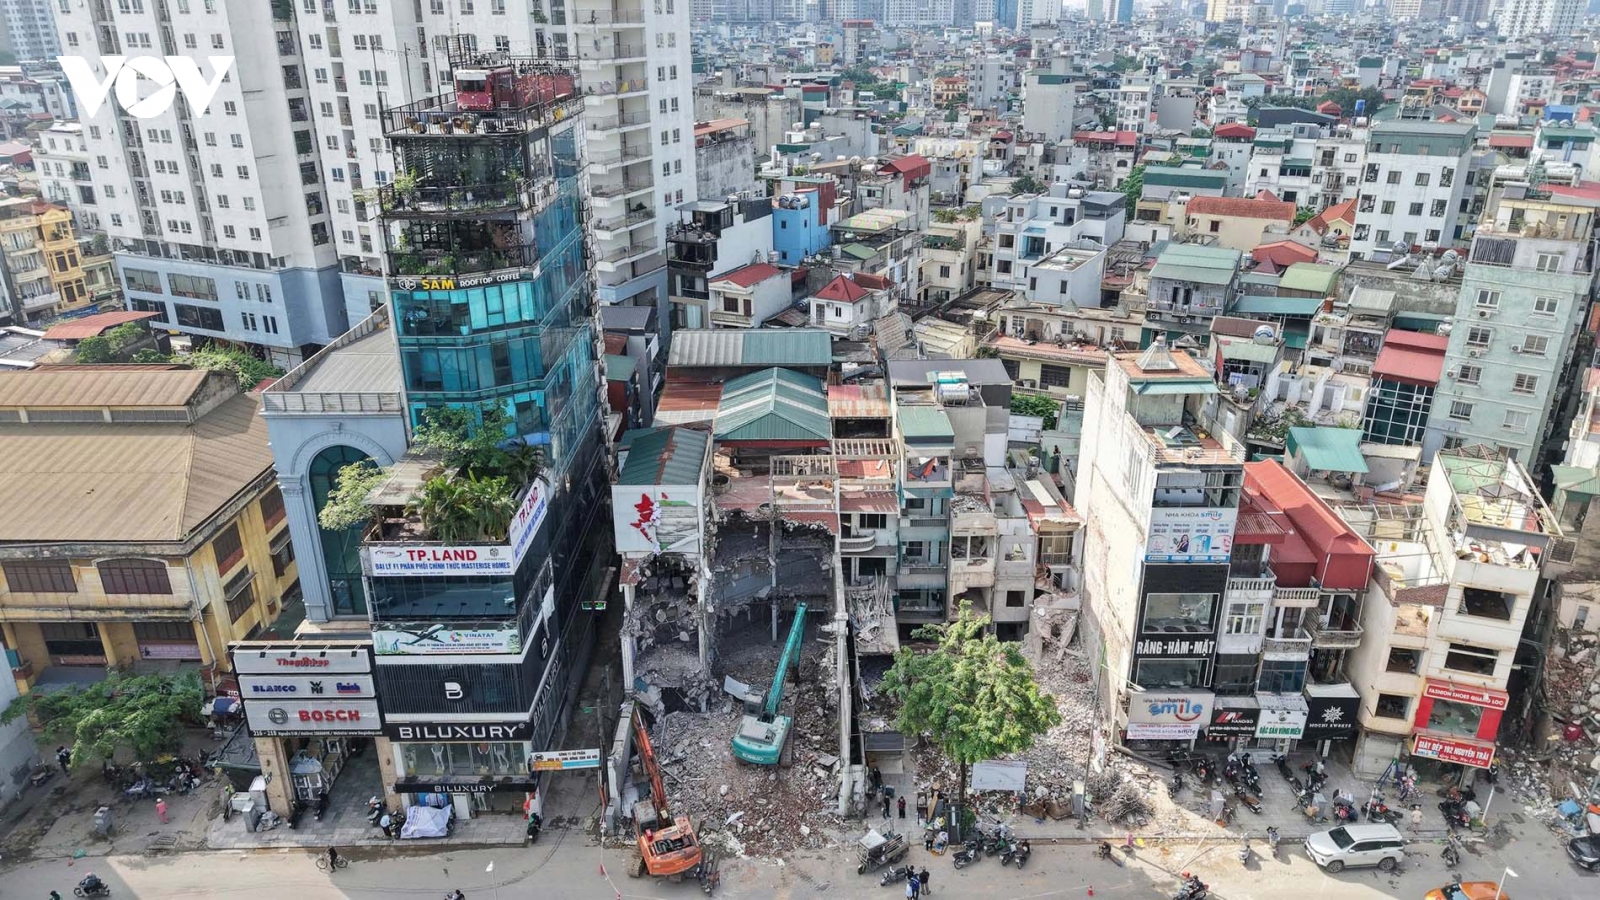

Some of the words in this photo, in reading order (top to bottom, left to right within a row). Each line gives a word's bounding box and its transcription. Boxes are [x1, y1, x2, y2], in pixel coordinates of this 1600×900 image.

[460, 277, 493, 288] ROOFTOP
[496, 273, 520, 282] COFFEE
[406, 549, 478, 562] TP.LAND
[461, 562, 491, 570] MASTERISE
[491, 561, 511, 569] HOMES
[1428, 688, 1452, 696] FASHION
[1452, 692, 1470, 700] SHOES
[1148, 699, 1203, 716] smile
[298, 710, 360, 722] BOSCH
[399, 727, 517, 738] BILUXURY
